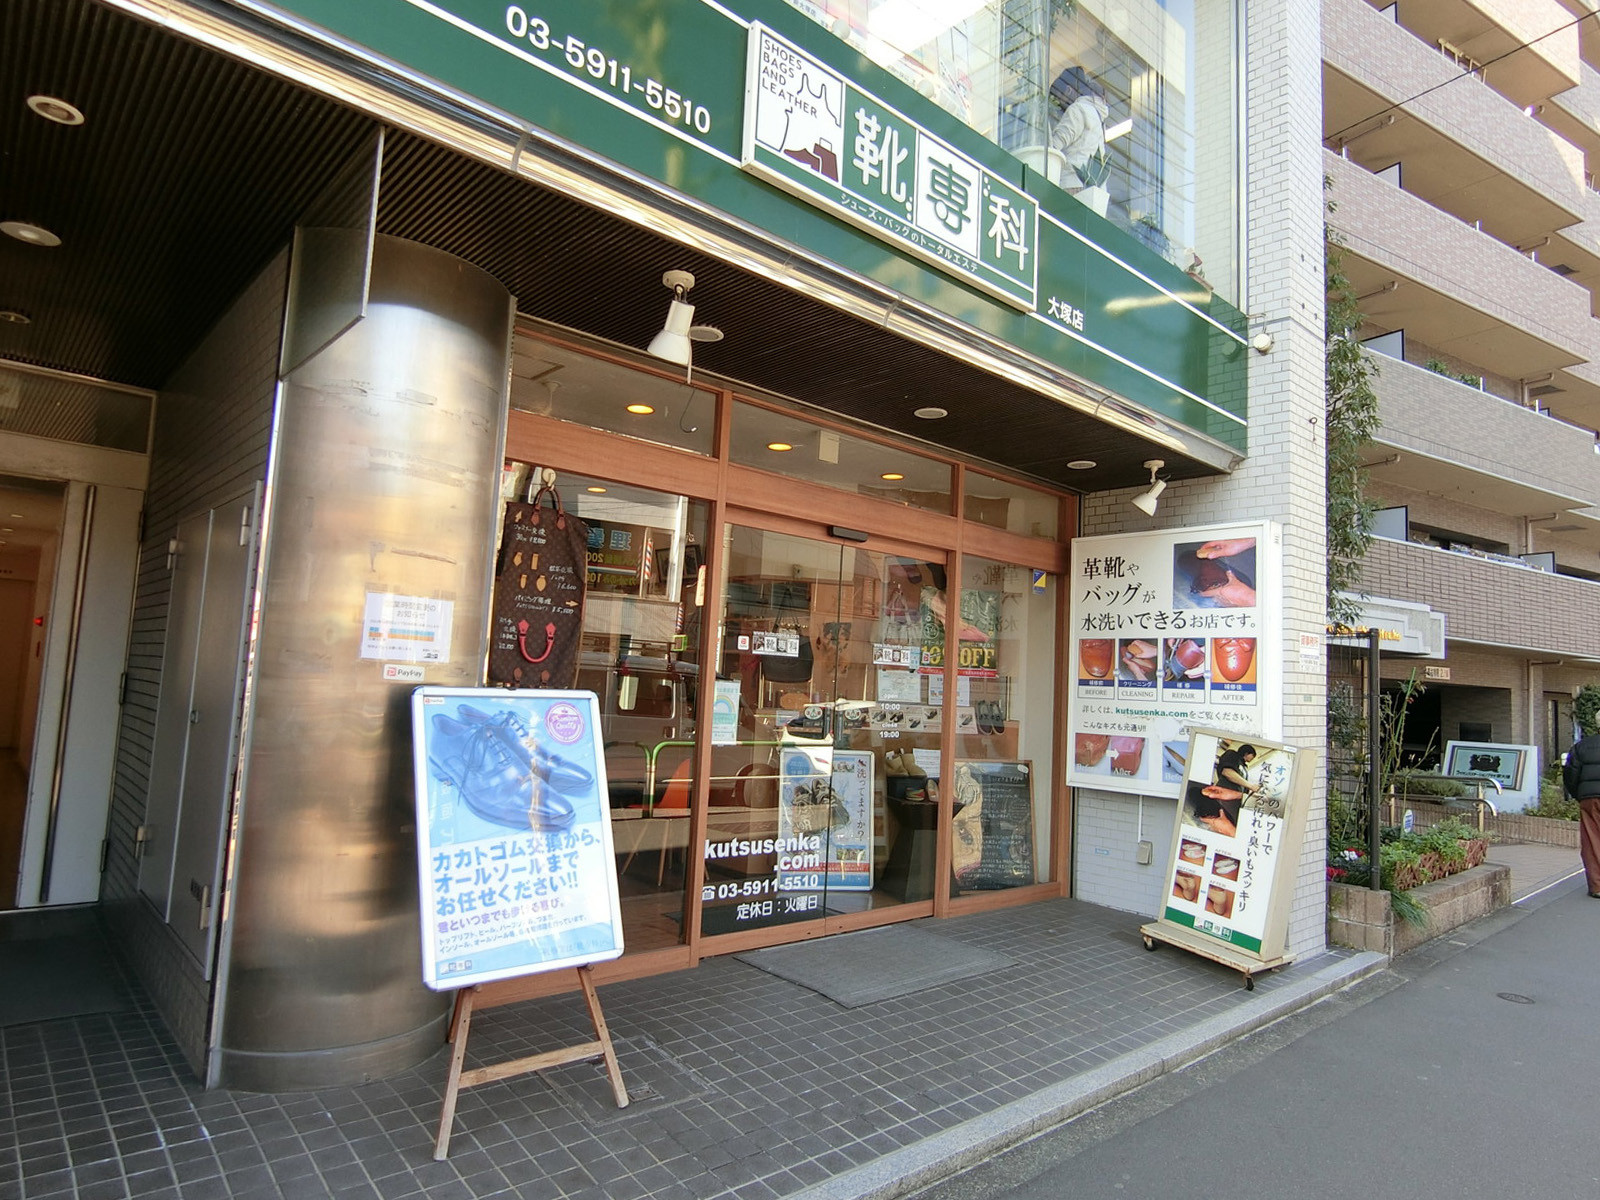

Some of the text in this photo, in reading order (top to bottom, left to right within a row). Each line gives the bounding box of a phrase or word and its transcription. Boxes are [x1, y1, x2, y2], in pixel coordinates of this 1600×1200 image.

[763, 51, 795, 78] BAGS
[764, 39, 802, 70] SHOES
[506, 5, 711, 134] 03-5911-5510
[762, 66, 787, 86] AND
[762, 77, 818, 119] LEATHER
[853, 107, 1029, 271] 靴専科
[840, 192, 978, 273] シューズ・バッグのトータルエステ
[1047, 296, 1084, 331] 大塚店
[1082, 556, 1140, 581] 革靴や
[1082, 583, 1156, 607] バッグが
[1081, 610, 1256, 632] 水洗いできるお店です。
[959, 648, 996, 668] OFF
[397, 668, 422, 679] PayPay
[1084, 688, 1108, 697] BEFORE
[1121, 690, 1154, 699] CLEANING
[1171, 692, 1196, 700] REPAIR
[1221, 693, 1245, 702] AFTER
[880, 702, 901, 711] 10:00
[879, 730, 900, 739] 19:00
[1112, 767, 1132, 777] After
[1261, 764, 1287, 856] オゾンのパワーで
[433, 828, 600, 873] カカトゴム交換から、
[704, 832, 821, 860] kutsusenka
[434, 850, 580, 893] オールソールまで
[773, 851, 820, 871] .com
[436, 871, 579, 917] お任せください!!
[718, 874, 819, 899] 03-5911-5510
